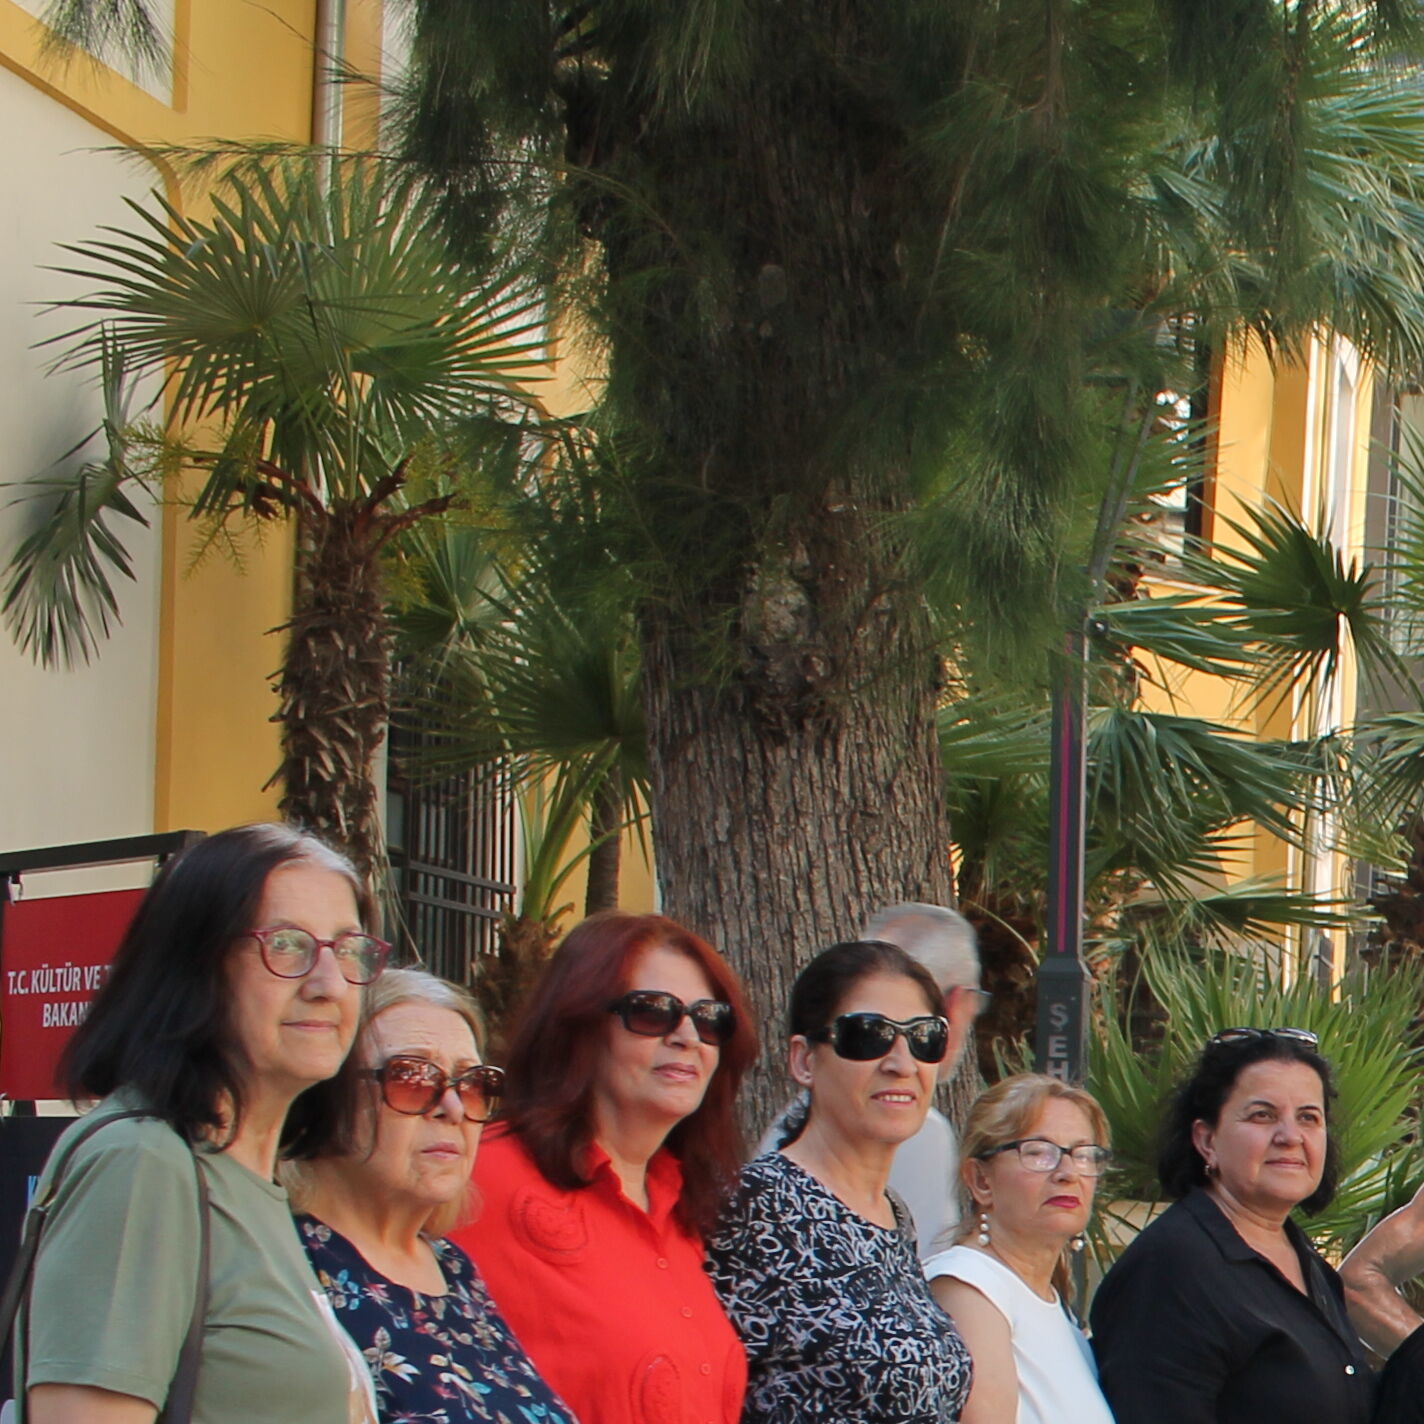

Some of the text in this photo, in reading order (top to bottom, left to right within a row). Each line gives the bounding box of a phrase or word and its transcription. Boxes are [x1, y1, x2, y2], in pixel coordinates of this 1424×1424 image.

[8, 970, 29, 995] T.C.
[31, 961, 81, 994] KÜLTÜR
[84, 965, 101, 990] VE
[43, 1001, 91, 1028] BAKAN
